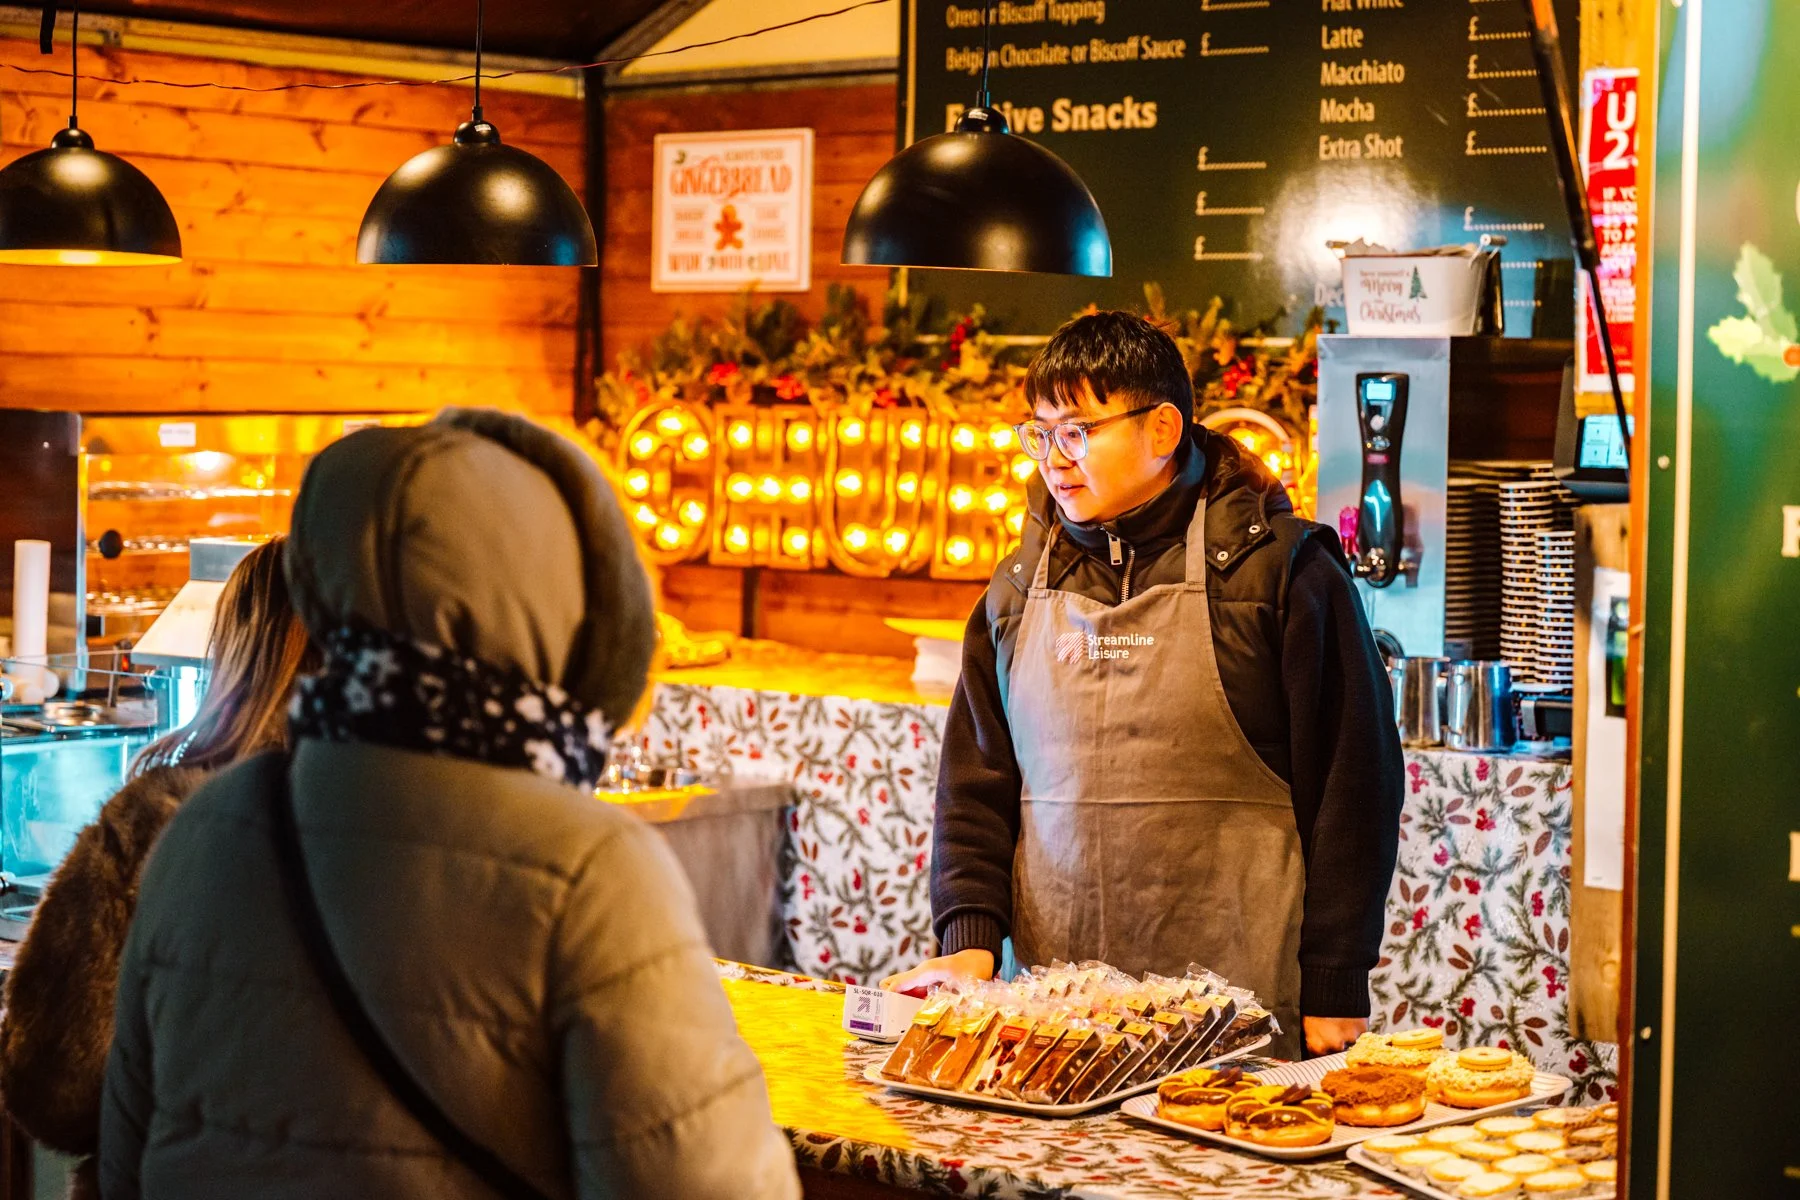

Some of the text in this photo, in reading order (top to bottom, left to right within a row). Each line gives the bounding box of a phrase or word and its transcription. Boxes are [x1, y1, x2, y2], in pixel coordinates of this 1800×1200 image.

[1321, 24, 1364, 50] Latte
[946, 34, 1187, 75] Belgin Chocolate or Biscoff Sauce
[1320, 59, 1405, 87] Macchiato
[945, 95, 1158, 134] Five Snacks
[1319, 97, 1375, 123] Mocha
[1318, 132, 1404, 161] Extra Shot
[1087, 633, 1154, 647] Streamline
[1087, 647, 1130, 660] Leisure
